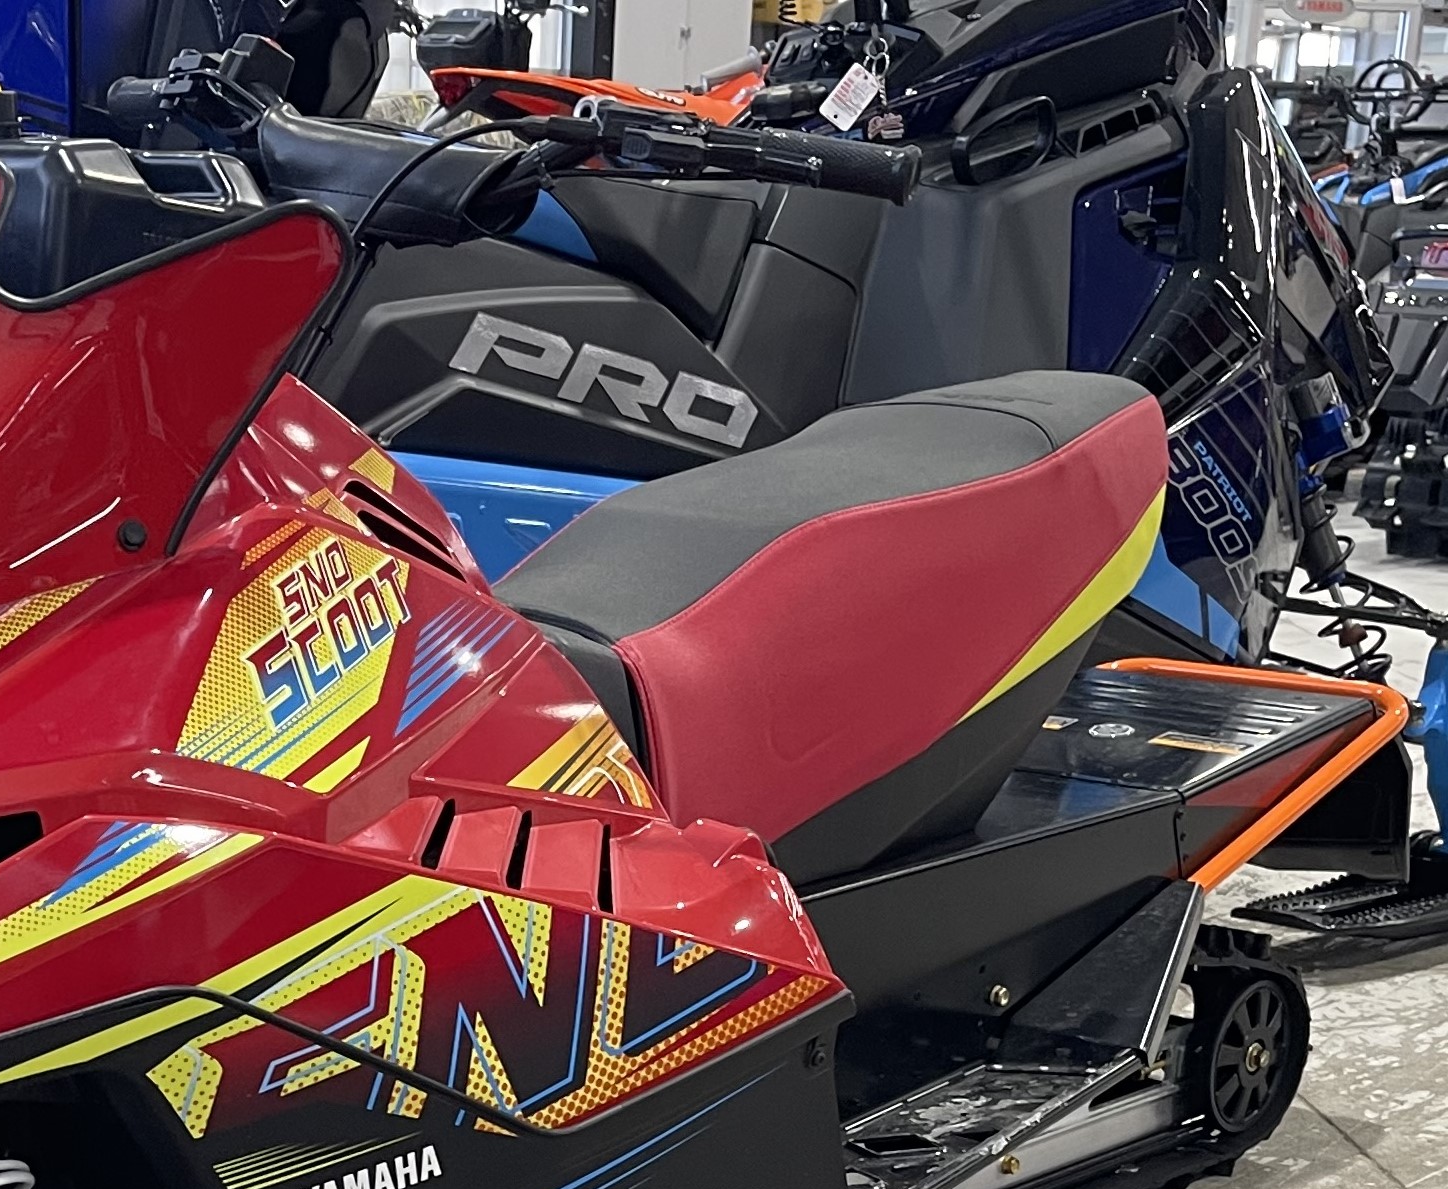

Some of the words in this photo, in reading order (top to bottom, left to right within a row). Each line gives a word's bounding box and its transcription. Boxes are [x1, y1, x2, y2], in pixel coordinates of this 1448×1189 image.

[449, 311, 759, 449] PRO
[1193, 440, 1253, 522] PATRIOT
[274, 537, 354, 630] SNO
[241, 555, 412, 733] SCOOT
